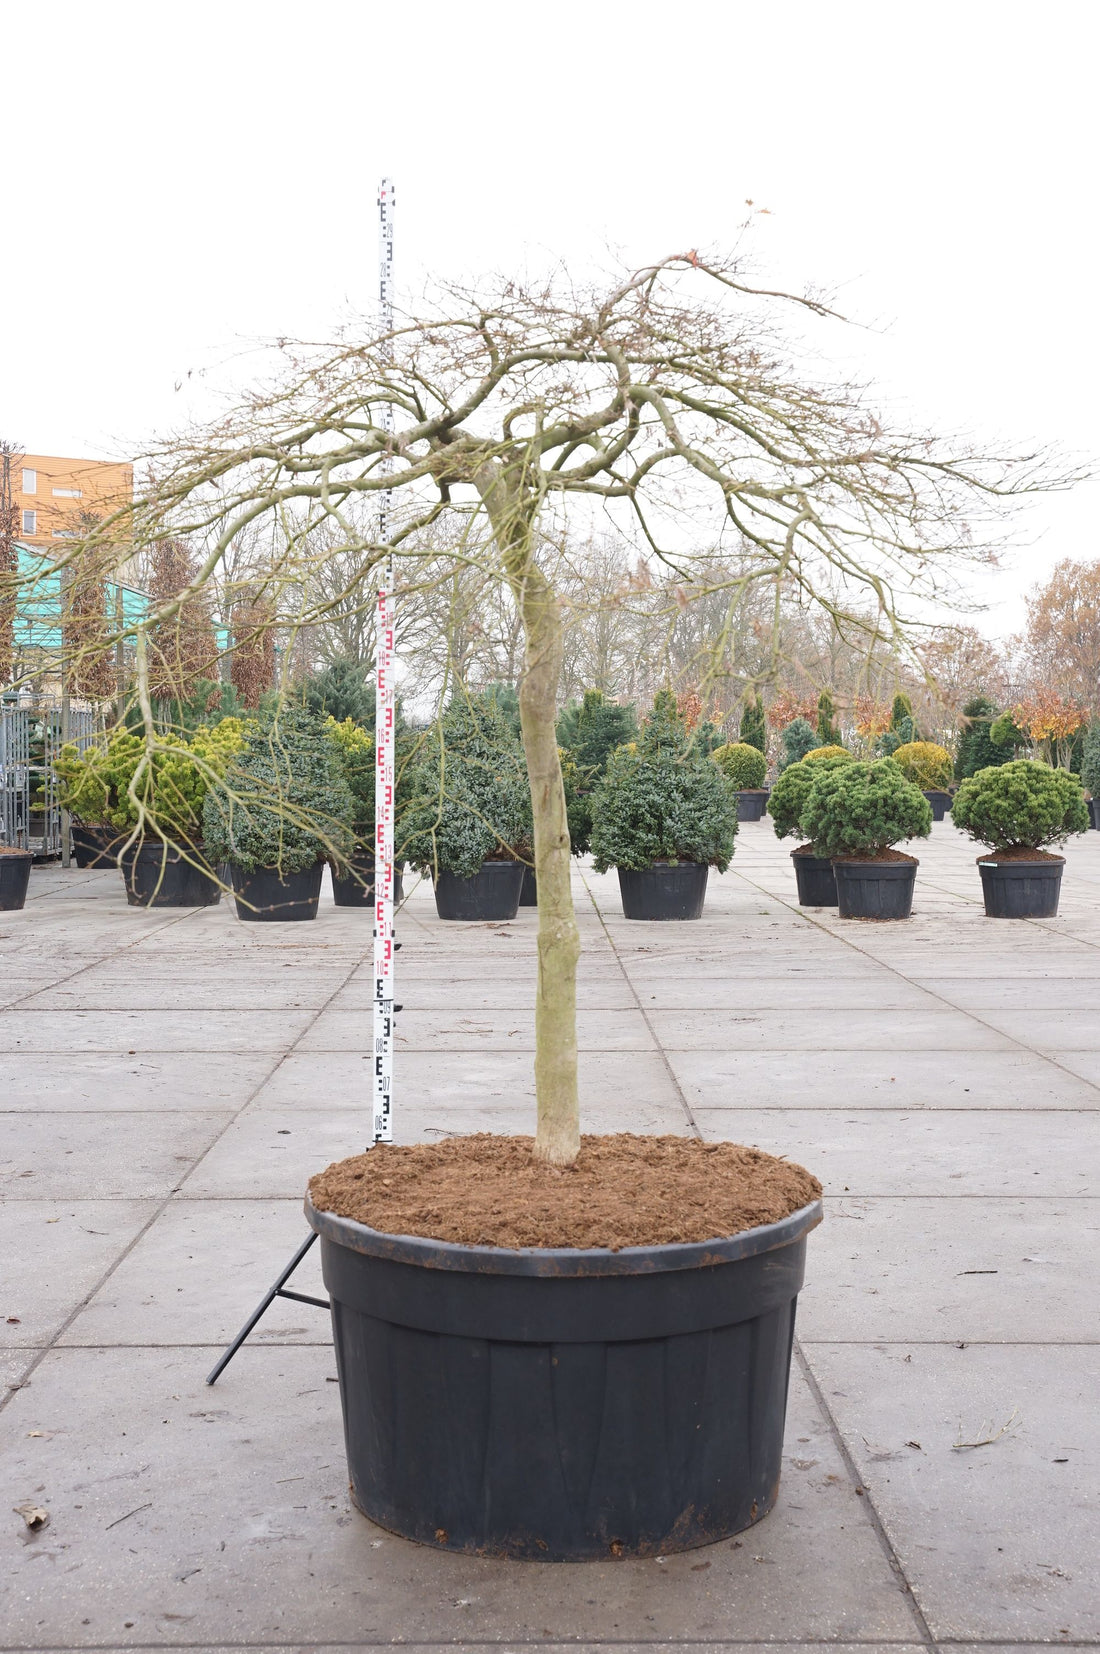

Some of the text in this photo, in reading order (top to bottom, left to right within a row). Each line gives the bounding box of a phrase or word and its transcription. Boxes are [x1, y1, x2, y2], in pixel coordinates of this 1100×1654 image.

[378, 650, 386, 666] 18
[385, 689, 393, 704] 17
[378, 728, 385, 744] 16
[385, 766, 393, 782] 15
[384, 844, 392, 860] 13
[377, 882, 385, 898] 12
[376, 960, 384, 976] 10
[384, 1001, 391, 1015] 09
[375, 1037, 384, 1053] 08
[382, 1076, 391, 1092] 07
[374, 1115, 383, 1131] 06
